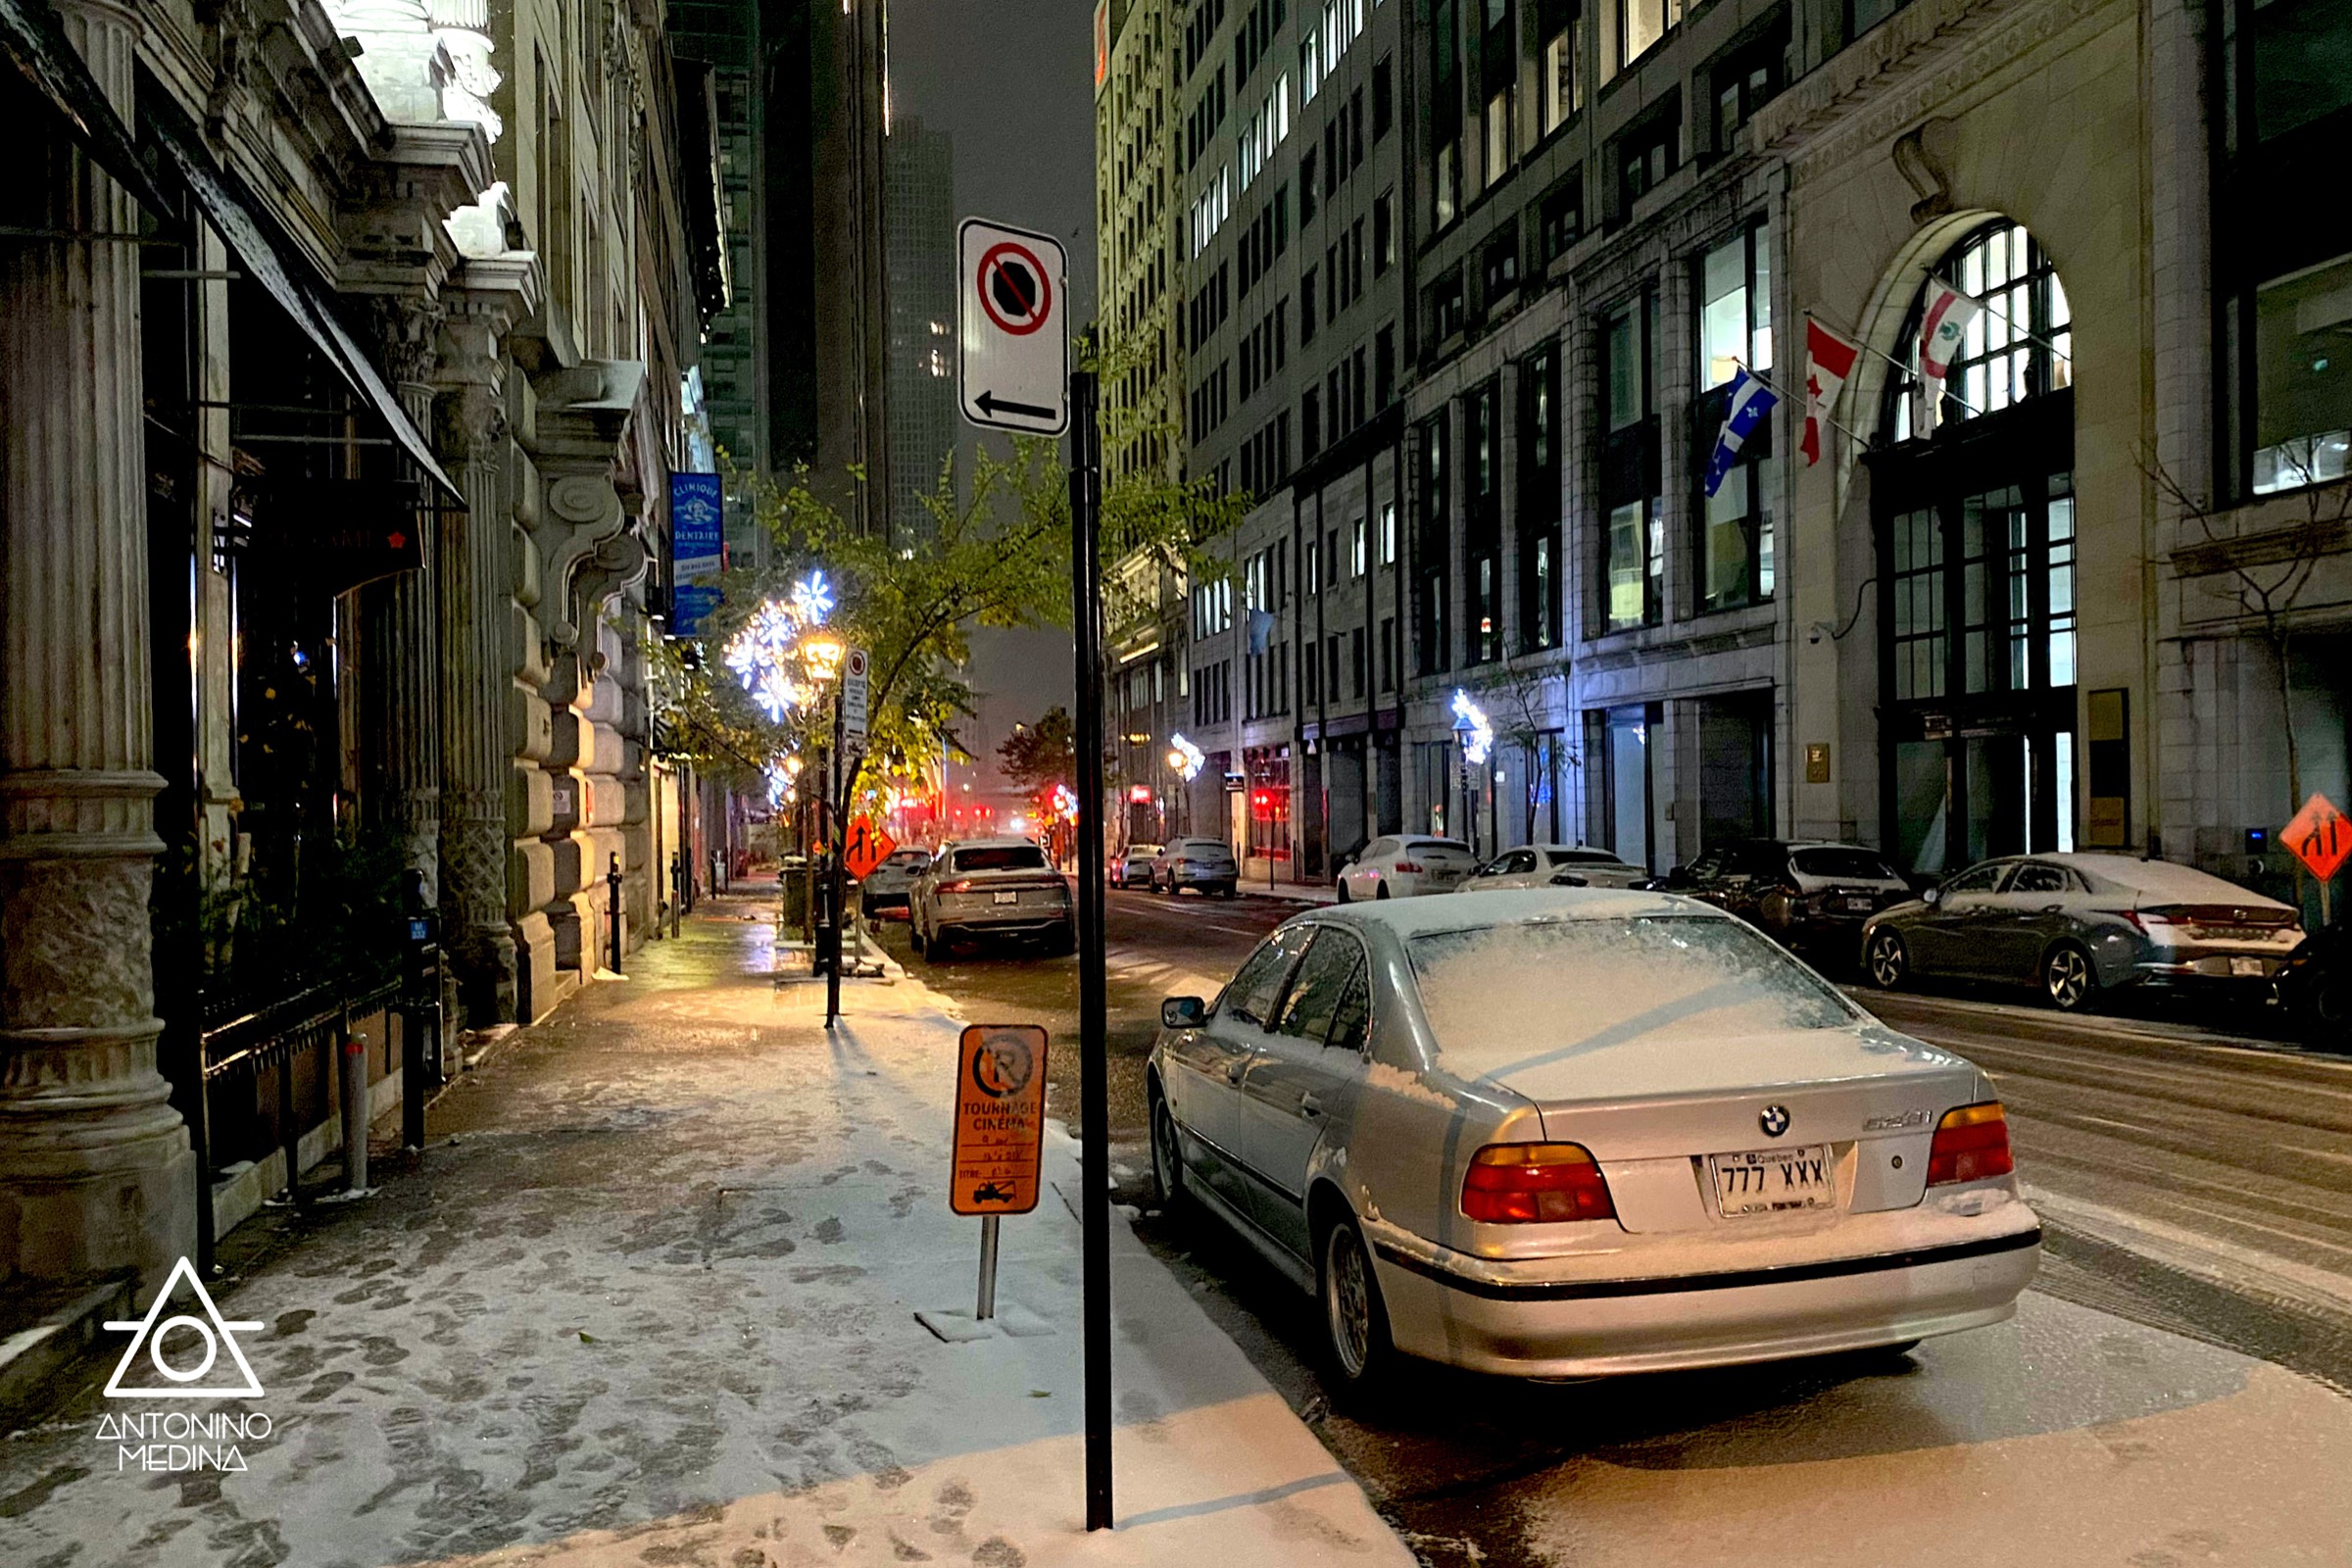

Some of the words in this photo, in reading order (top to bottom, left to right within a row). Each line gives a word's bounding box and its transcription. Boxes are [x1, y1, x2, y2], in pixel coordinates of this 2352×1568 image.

[673, 482, 718, 499] CLINIQUE
[674, 530, 719, 541] DENTAIRE
[963, 1102, 1036, 1115] TOURNAGE
[973, 1115, 1025, 1130] CINÉMA
[1722, 1166, 1765, 1192] 777
[1781, 1159, 1825, 1187] XXX
